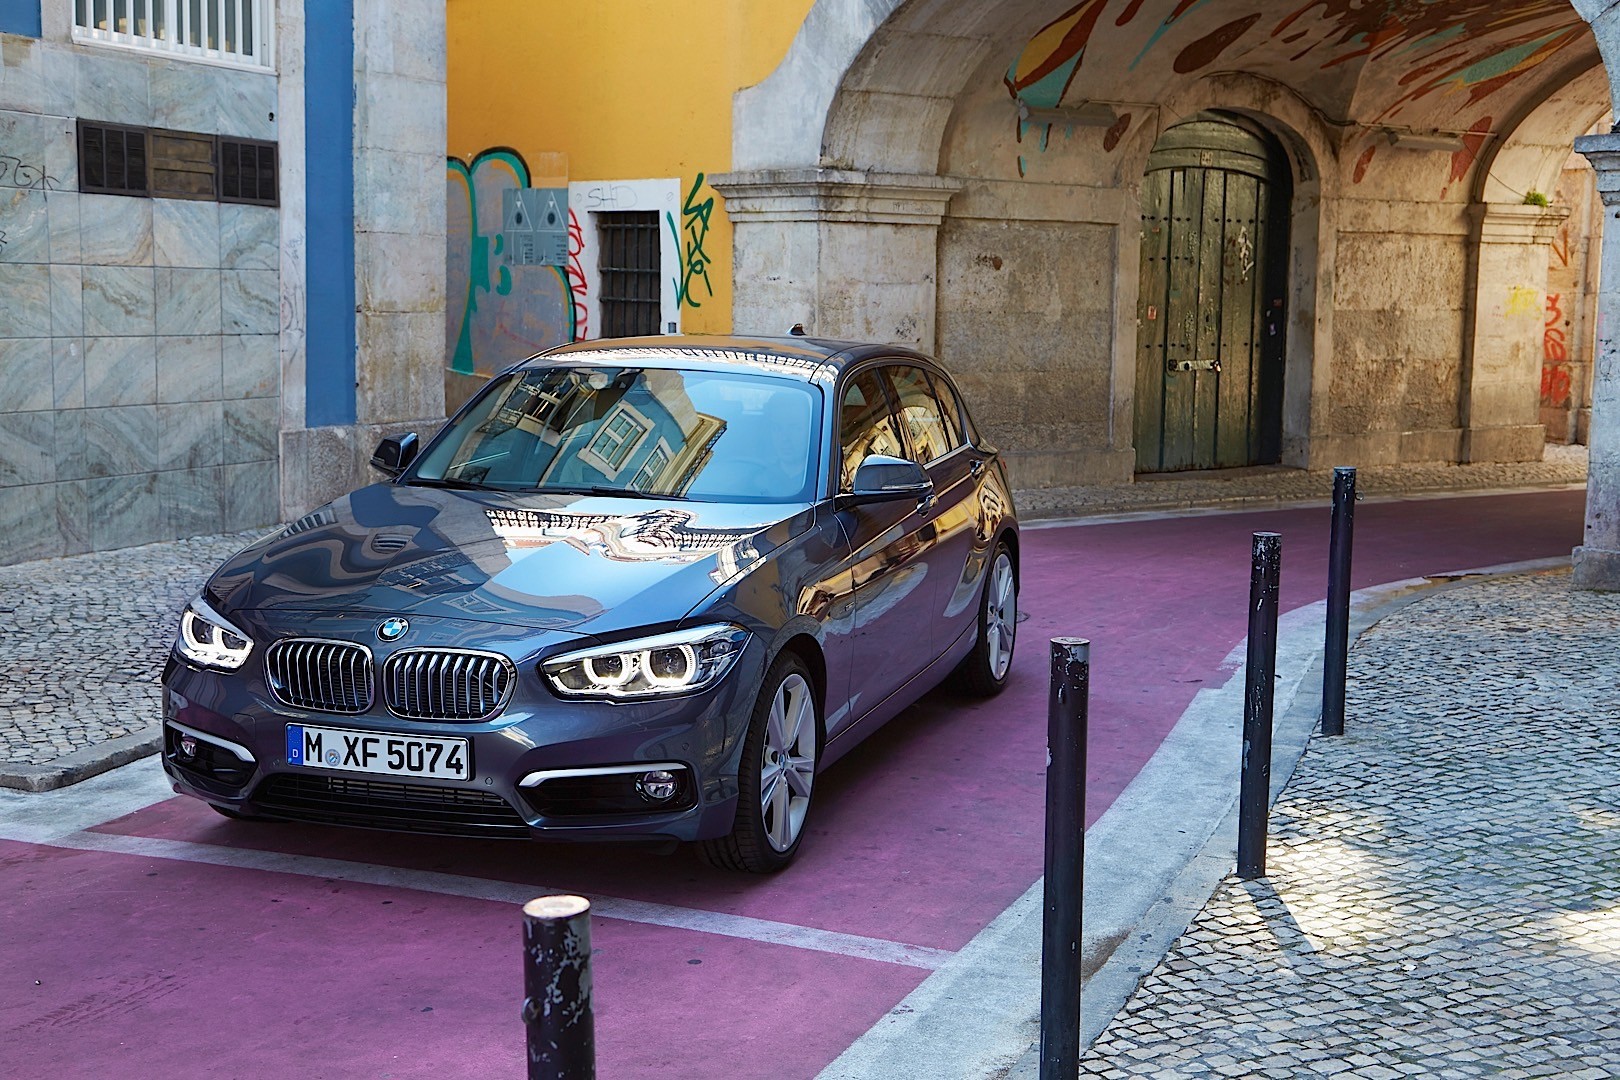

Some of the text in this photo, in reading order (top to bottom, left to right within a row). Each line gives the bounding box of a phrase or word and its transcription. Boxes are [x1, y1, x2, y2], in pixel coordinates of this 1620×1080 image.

[292, 748, 299, 758] D
[305, 731, 463, 774] M XF 5074
